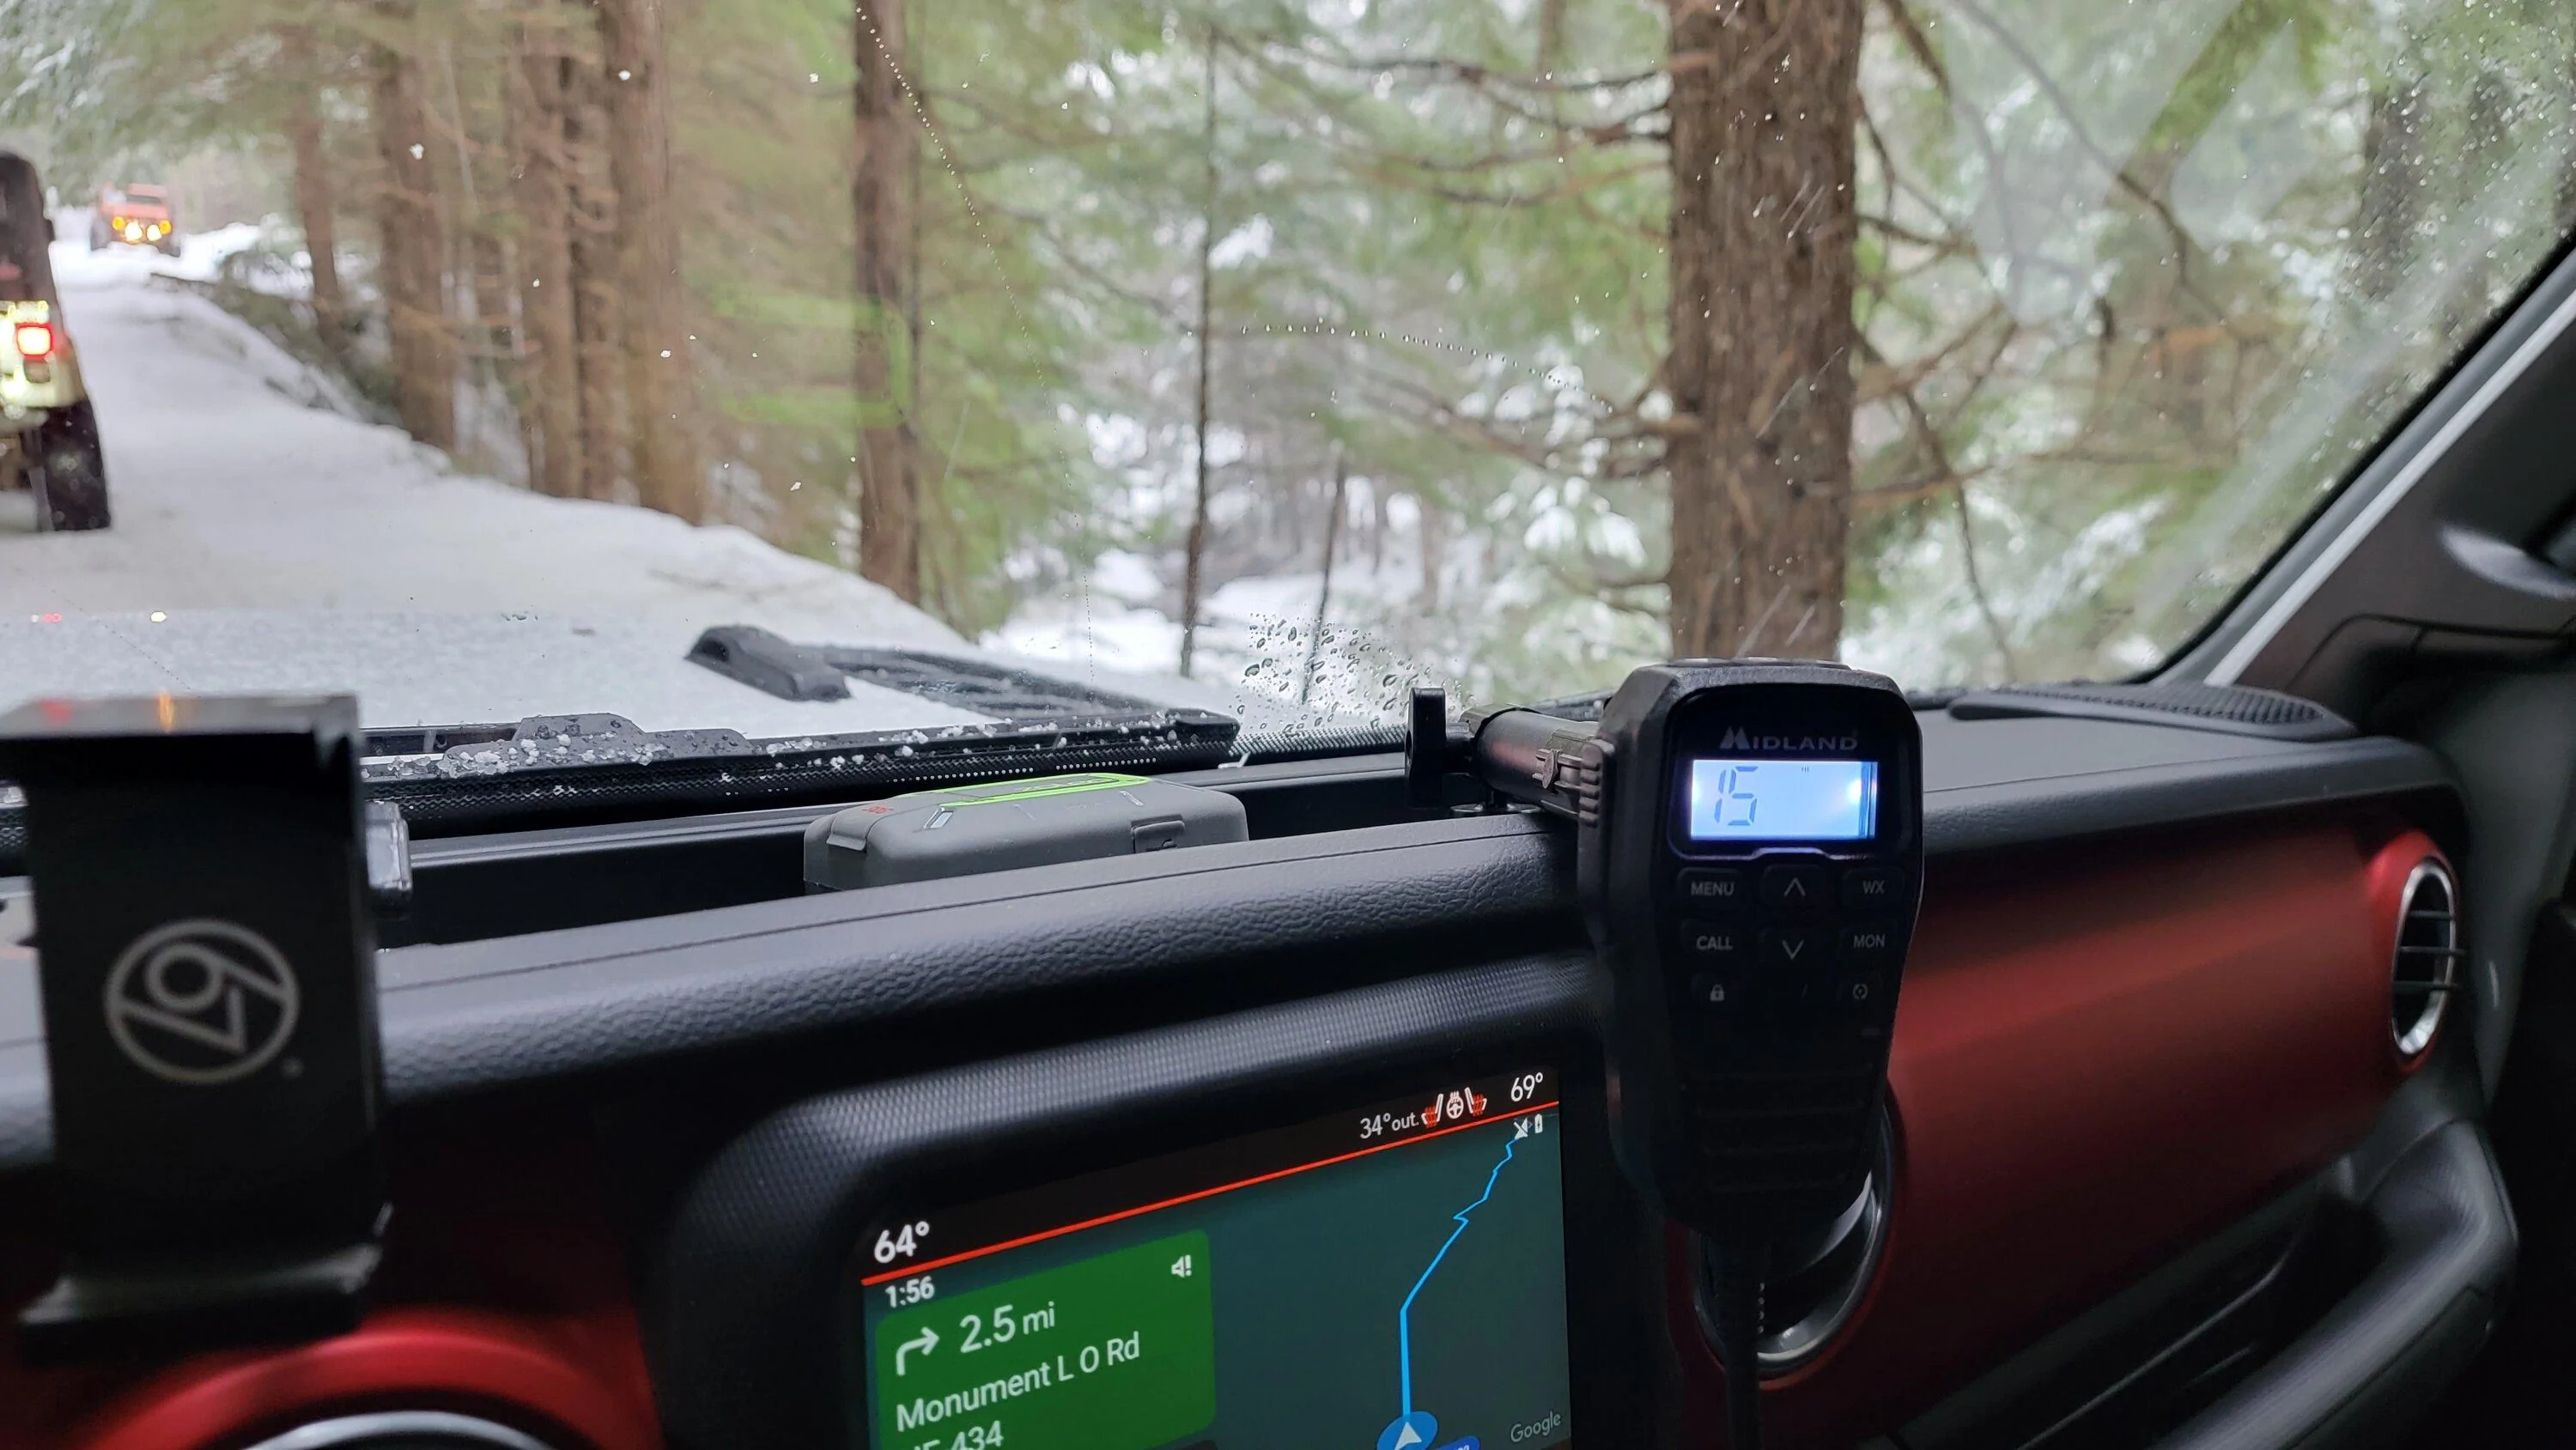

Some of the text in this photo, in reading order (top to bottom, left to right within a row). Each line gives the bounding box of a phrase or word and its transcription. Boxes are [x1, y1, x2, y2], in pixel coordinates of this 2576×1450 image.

[1720, 726, 1858, 751] MIDLAND
[1714, 765, 1759, 826] 15
[1690, 881, 1735, 896] MENU
[1862, 880, 1886, 895] WX
[1696, 935, 1733, 950] CALL
[1853, 934, 1886, 949] MON
[885, 1275, 935, 1308] 1:56
[959, 1301, 1055, 1354] 2.5 mi
[896, 1362, 1052, 1433] Monument
[1057, 1355, 1075, 1381] L
[1107, 1331, 1140, 1366] Rd
[950, 1420, 1005, 1450] 434
[1510, 1411, 1562, 1443] Google
